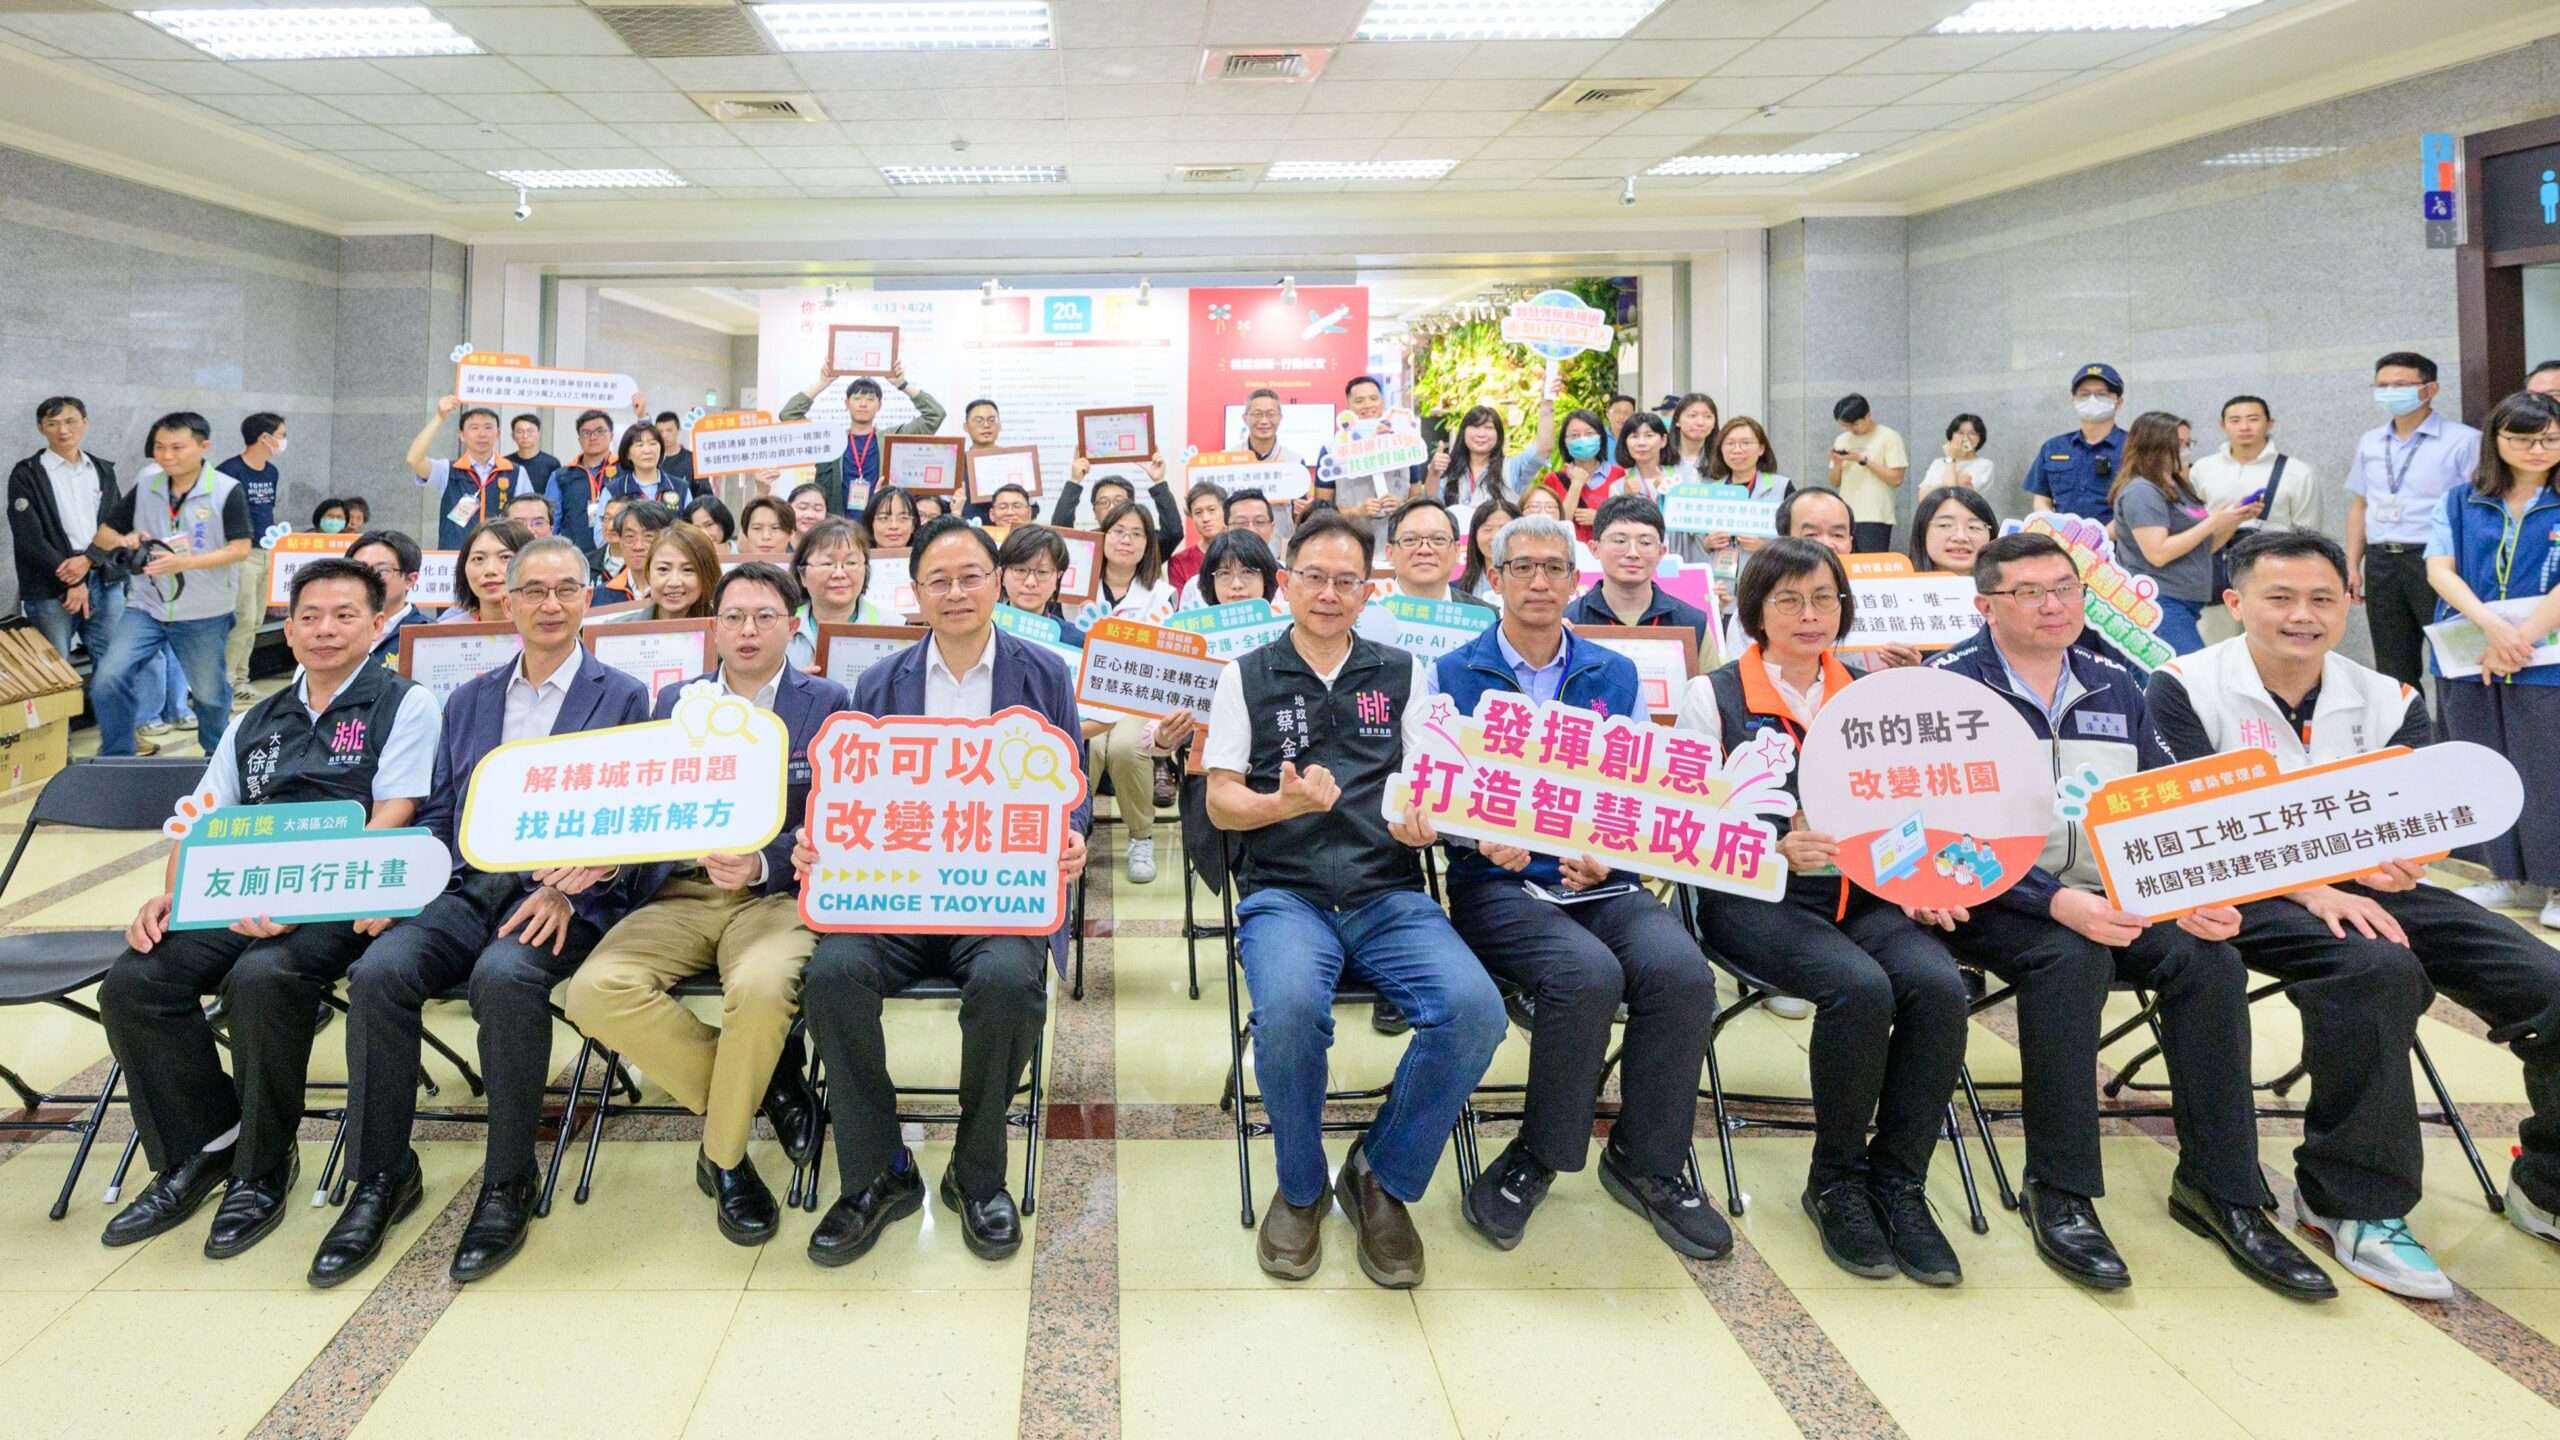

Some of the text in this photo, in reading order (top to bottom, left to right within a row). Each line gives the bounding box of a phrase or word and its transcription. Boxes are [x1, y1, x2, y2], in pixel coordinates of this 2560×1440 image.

[1105, 623, 1152, 644] 點子獎
[1275, 708, 1297, 759] 蔡金
[1294, 694, 1310, 748] 地政局長
[1840, 709, 1990, 750] 你的點子
[828, 732, 996, 785] 你可以
[1480, 698, 1715, 797] 發揮創意
[521, 753, 738, 794] 解構城市問題
[1848, 760, 2000, 801] 改變桃園
[2188, 762, 2268, 792] 建築管理處
[1408, 752, 1768, 881] 打造智慧政府
[2105, 778, 2184, 816] 點子獎
[206, 815, 275, 839] 創新獎
[283, 815, 348, 832] 大溪區公所
[513, 798, 736, 841] 找出創新解方
[824, 799, 1050, 854] 改變桃園
[2122, 787, 2374, 868] 桃園工地工好平台
[2134, 803, 2478, 899] 桃園智慧建管資訊圖台精進計畫
[203, 857, 409, 899] 友廁同行計畫
[938, 867, 1047, 887] YOU CAN
[818, 893, 1046, 914] CHANGE TAOYUAN
